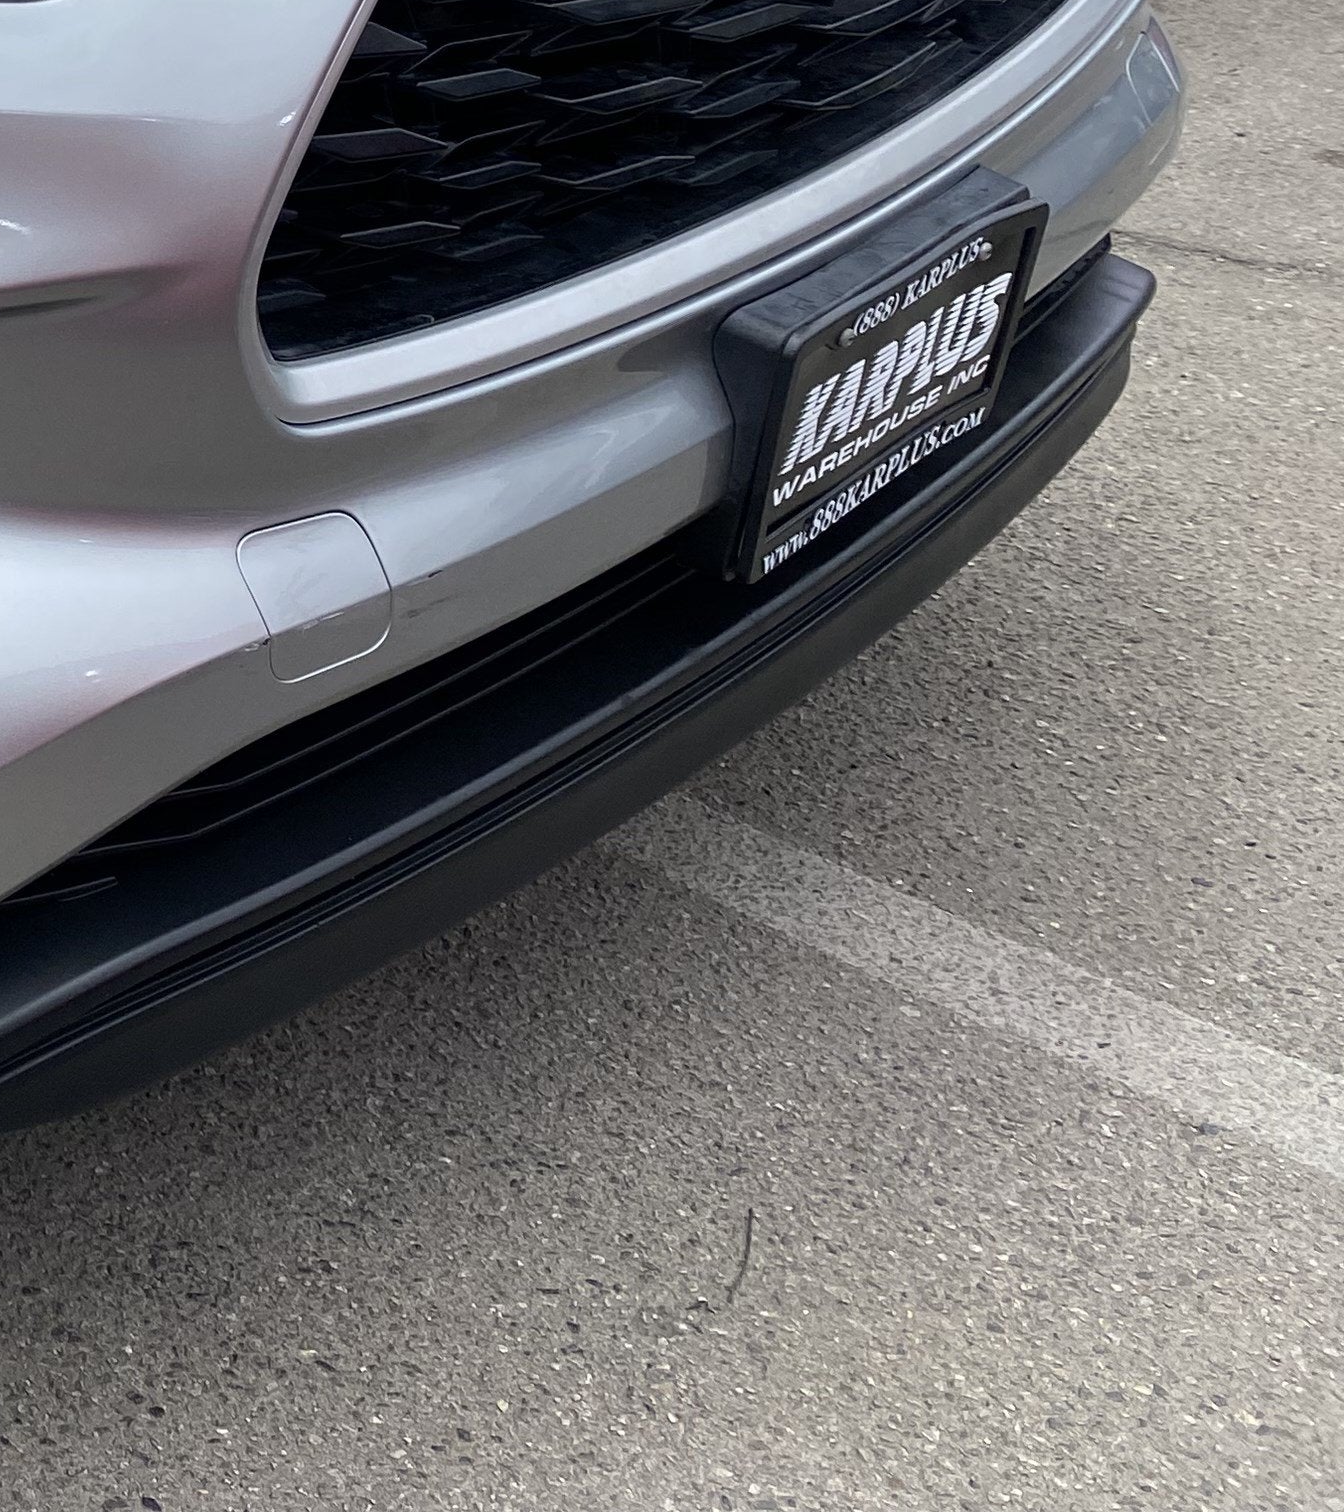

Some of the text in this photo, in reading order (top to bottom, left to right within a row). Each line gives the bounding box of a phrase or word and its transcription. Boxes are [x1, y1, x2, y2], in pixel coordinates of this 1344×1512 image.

[853, 237, 984, 336] (888) KARPLUS
[773, 354, 990, 507] WAREHOUSE INC
[778, 272, 1013, 476] KARPLUS
